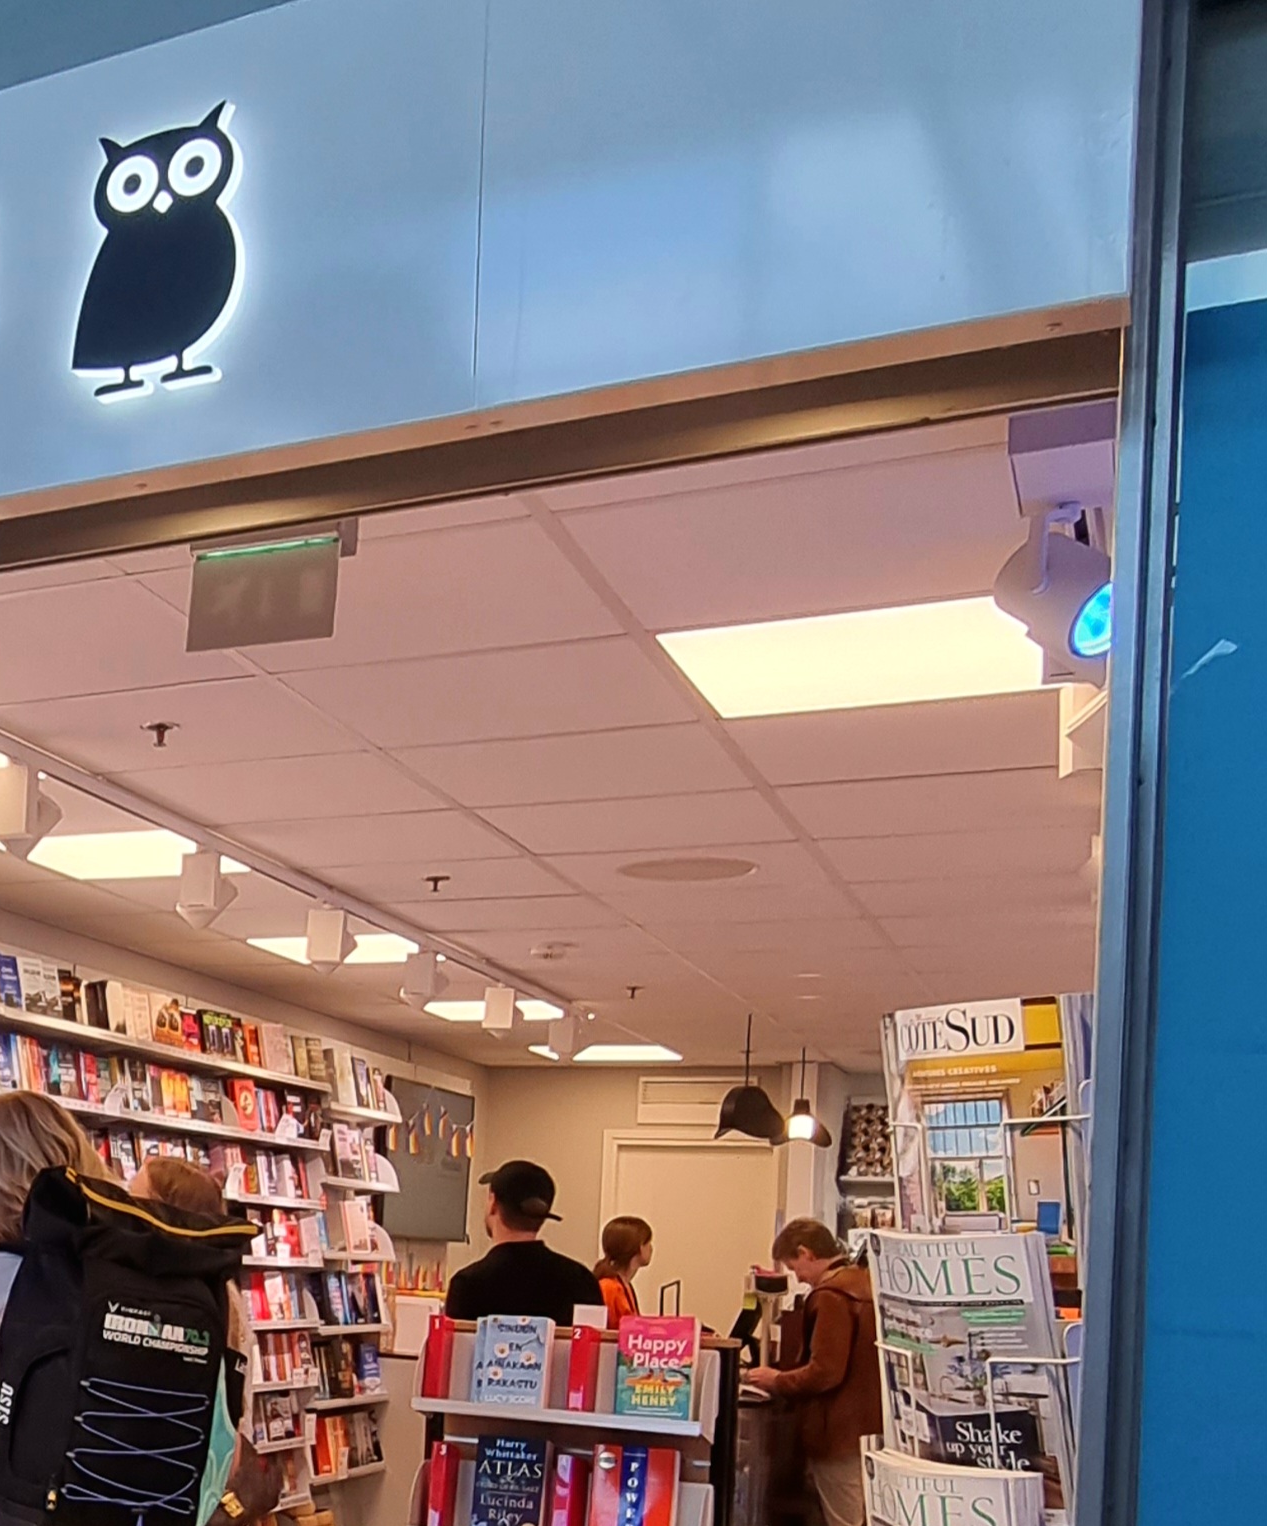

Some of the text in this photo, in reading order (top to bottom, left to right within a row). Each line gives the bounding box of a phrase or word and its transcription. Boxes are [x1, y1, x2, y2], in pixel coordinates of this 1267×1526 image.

[877, 1254, 1022, 1297] HOMES
[102, 1328, 141, 1346] WORLD
[627, 1334, 687, 1356] Happy
[633, 1352, 681, 1369] Place
[631, 1394, 677, 1407] HENRY
[955, 1421, 1023, 1445] Shake
[496, 1439, 527, 1450] Harry
[946, 1441, 965, 1459] up
[478, 1459, 544, 1479] ATLAS
[480, 1494, 534, 1510] Lucinda
[488, 1508, 523, 1525] Riley
